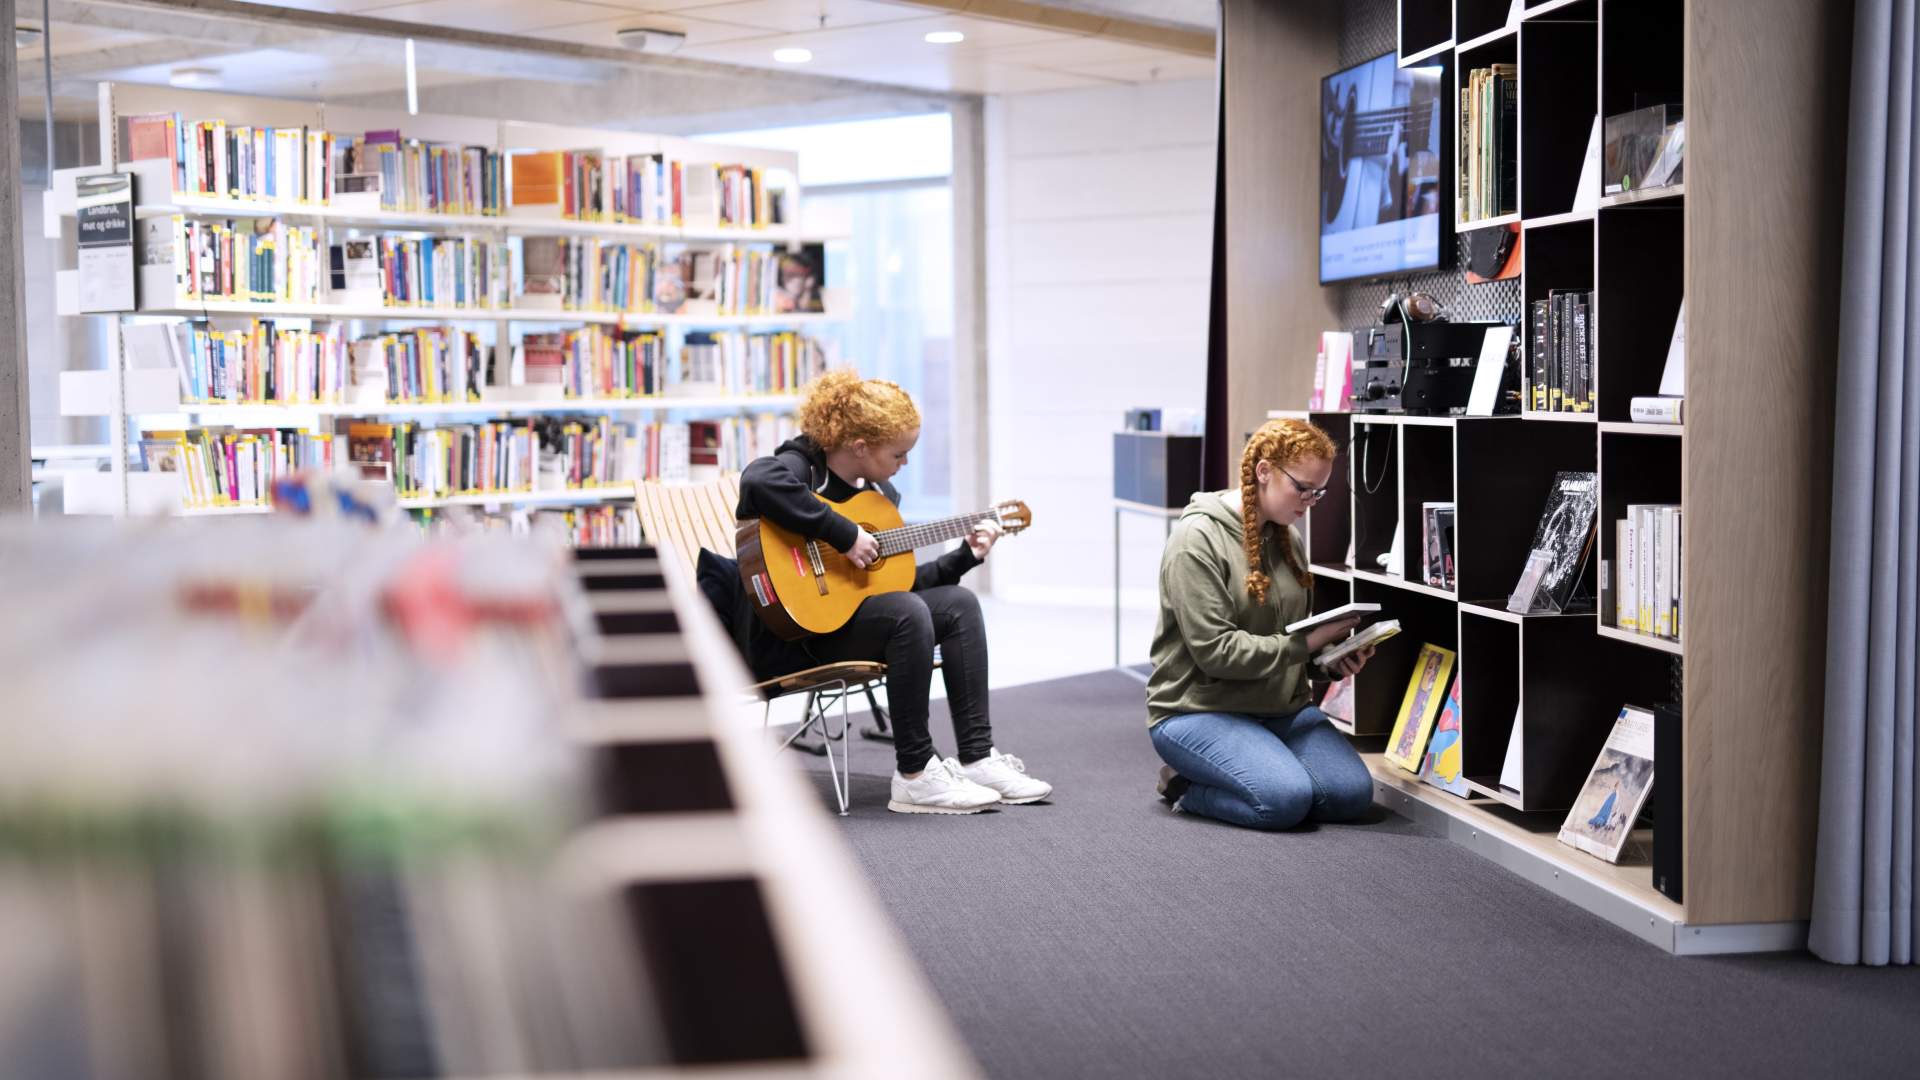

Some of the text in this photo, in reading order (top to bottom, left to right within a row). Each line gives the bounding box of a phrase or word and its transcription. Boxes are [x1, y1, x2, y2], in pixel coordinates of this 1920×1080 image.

[82, 219, 126, 232] mat og drikke
